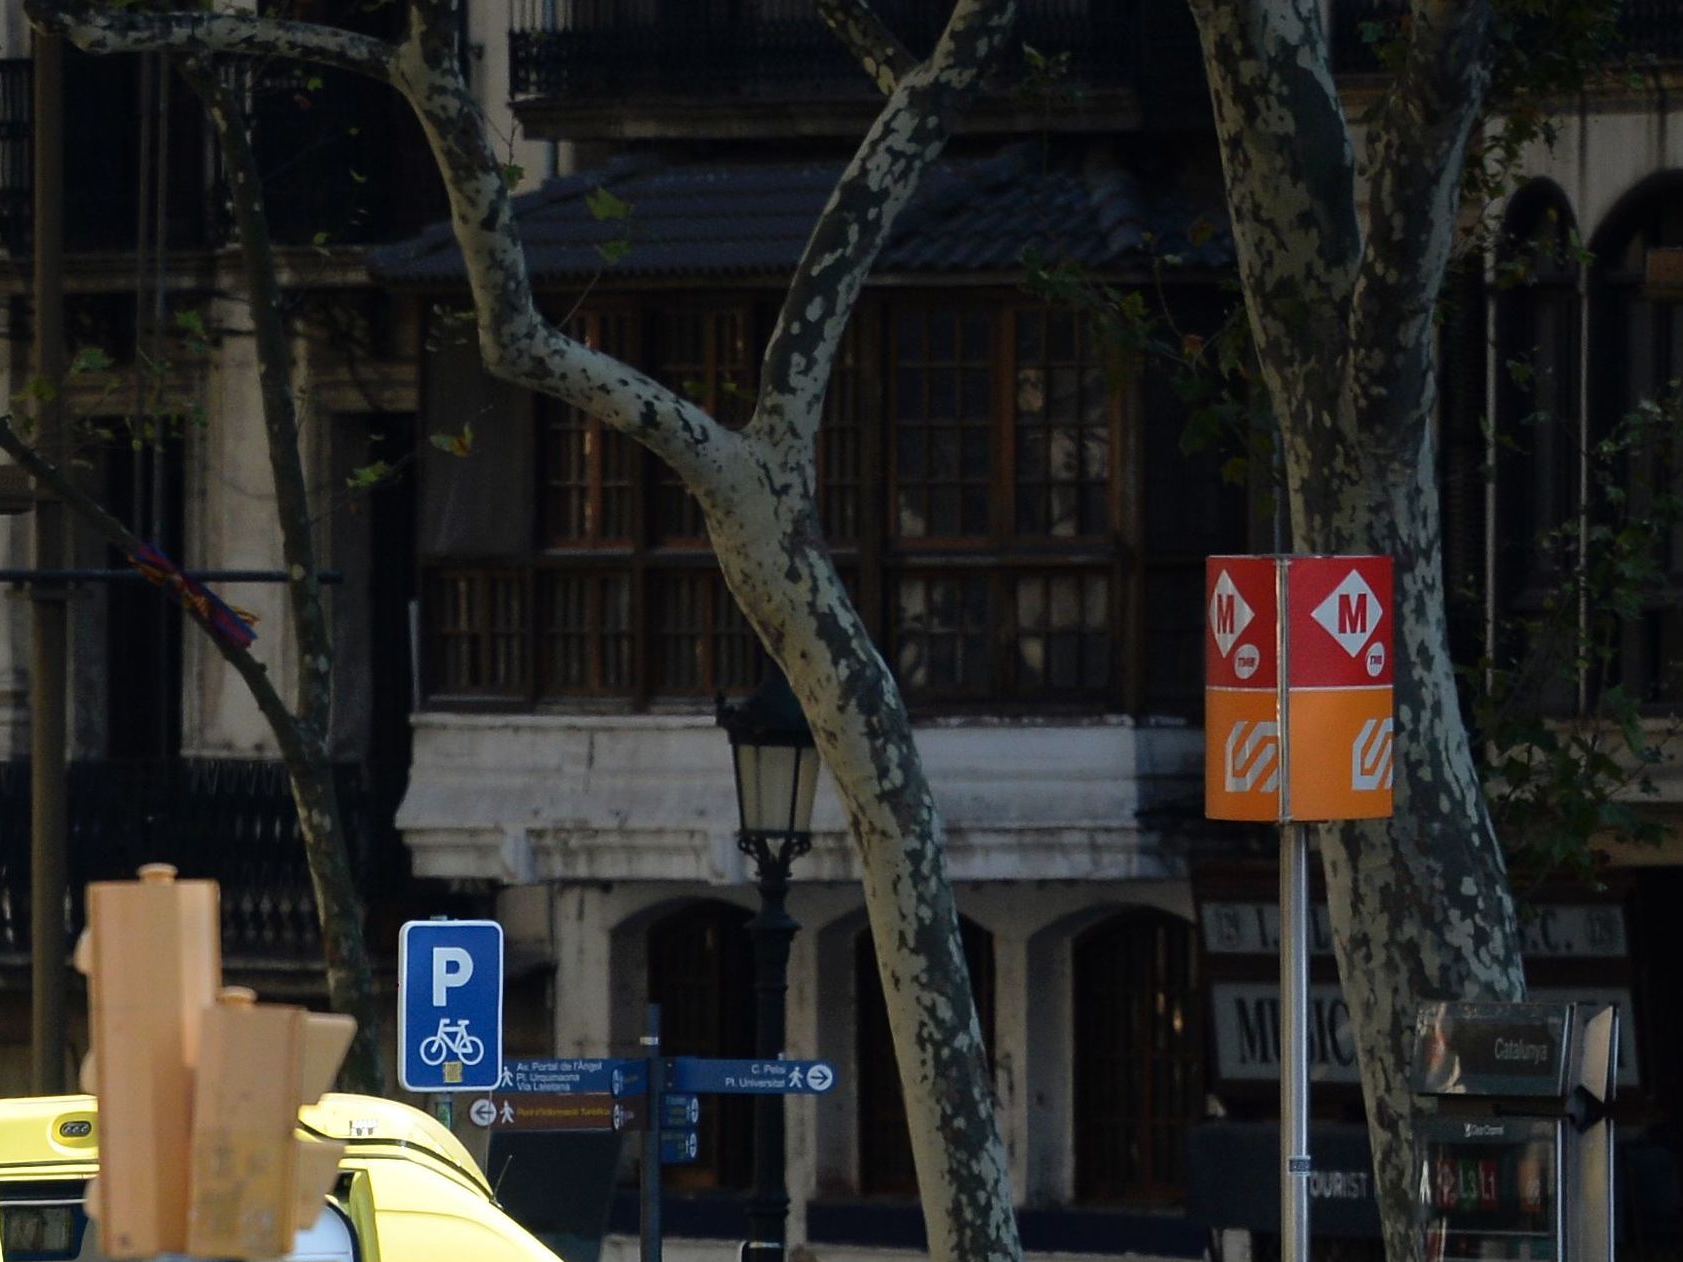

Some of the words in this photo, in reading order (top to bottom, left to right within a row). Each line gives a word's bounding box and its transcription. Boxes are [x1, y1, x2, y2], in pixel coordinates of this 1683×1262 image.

[1218, 594, 1235, 634] M
[1339, 594, 1368, 634] M
[433, 947, 474, 1006] P
[1494, 1038, 1548, 1064] Catalunya
[1309, 1171, 1369, 1199] OURIST
